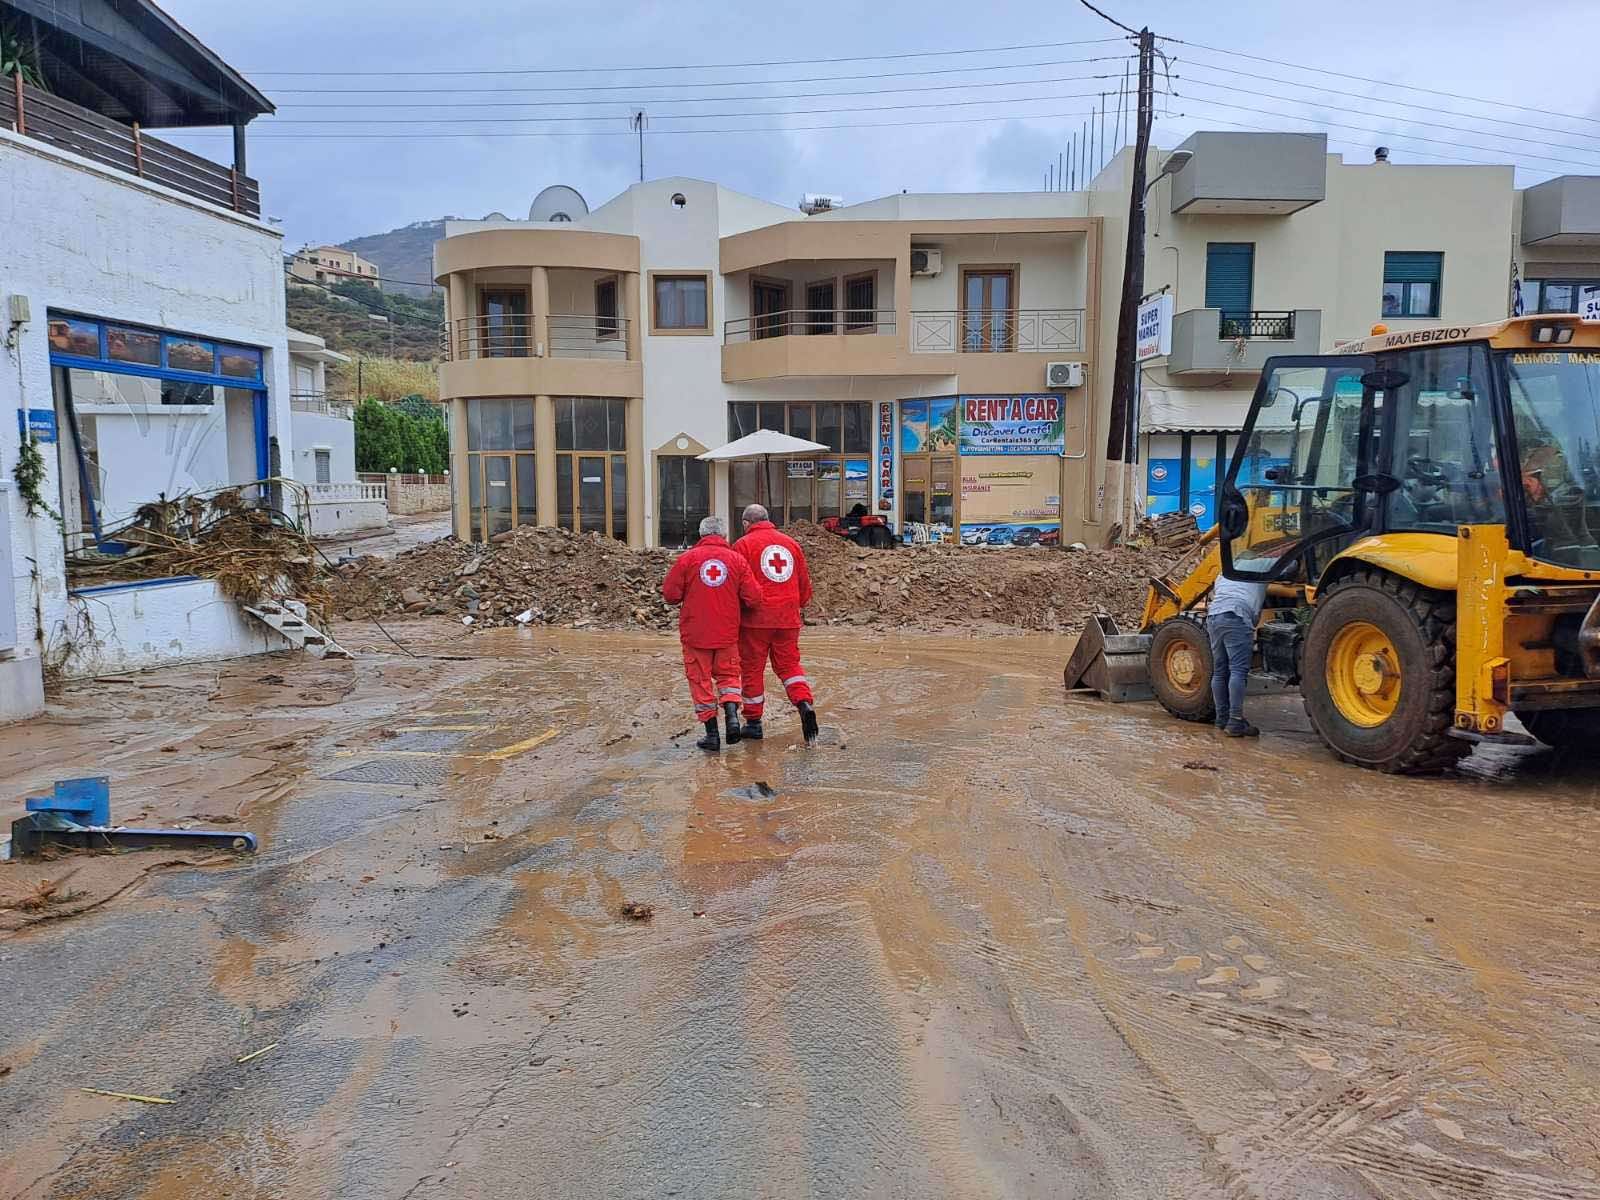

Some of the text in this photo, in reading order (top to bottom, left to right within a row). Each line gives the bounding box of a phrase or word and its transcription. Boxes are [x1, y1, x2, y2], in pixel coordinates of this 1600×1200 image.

[1141, 308, 1158, 326] SUPER
[1138, 322, 1159, 341] MARKET
[1385, 327, 1471, 348] ΜΑΛΕΒΙΖΙΟΥ
[1513, 353, 1560, 364] ΔΗΜΟΣ
[966, 398, 1059, 422] RENT A CAR
[972, 423, 1051, 437] Discover Crete!
[881, 404, 890, 488] RENT A CAR
